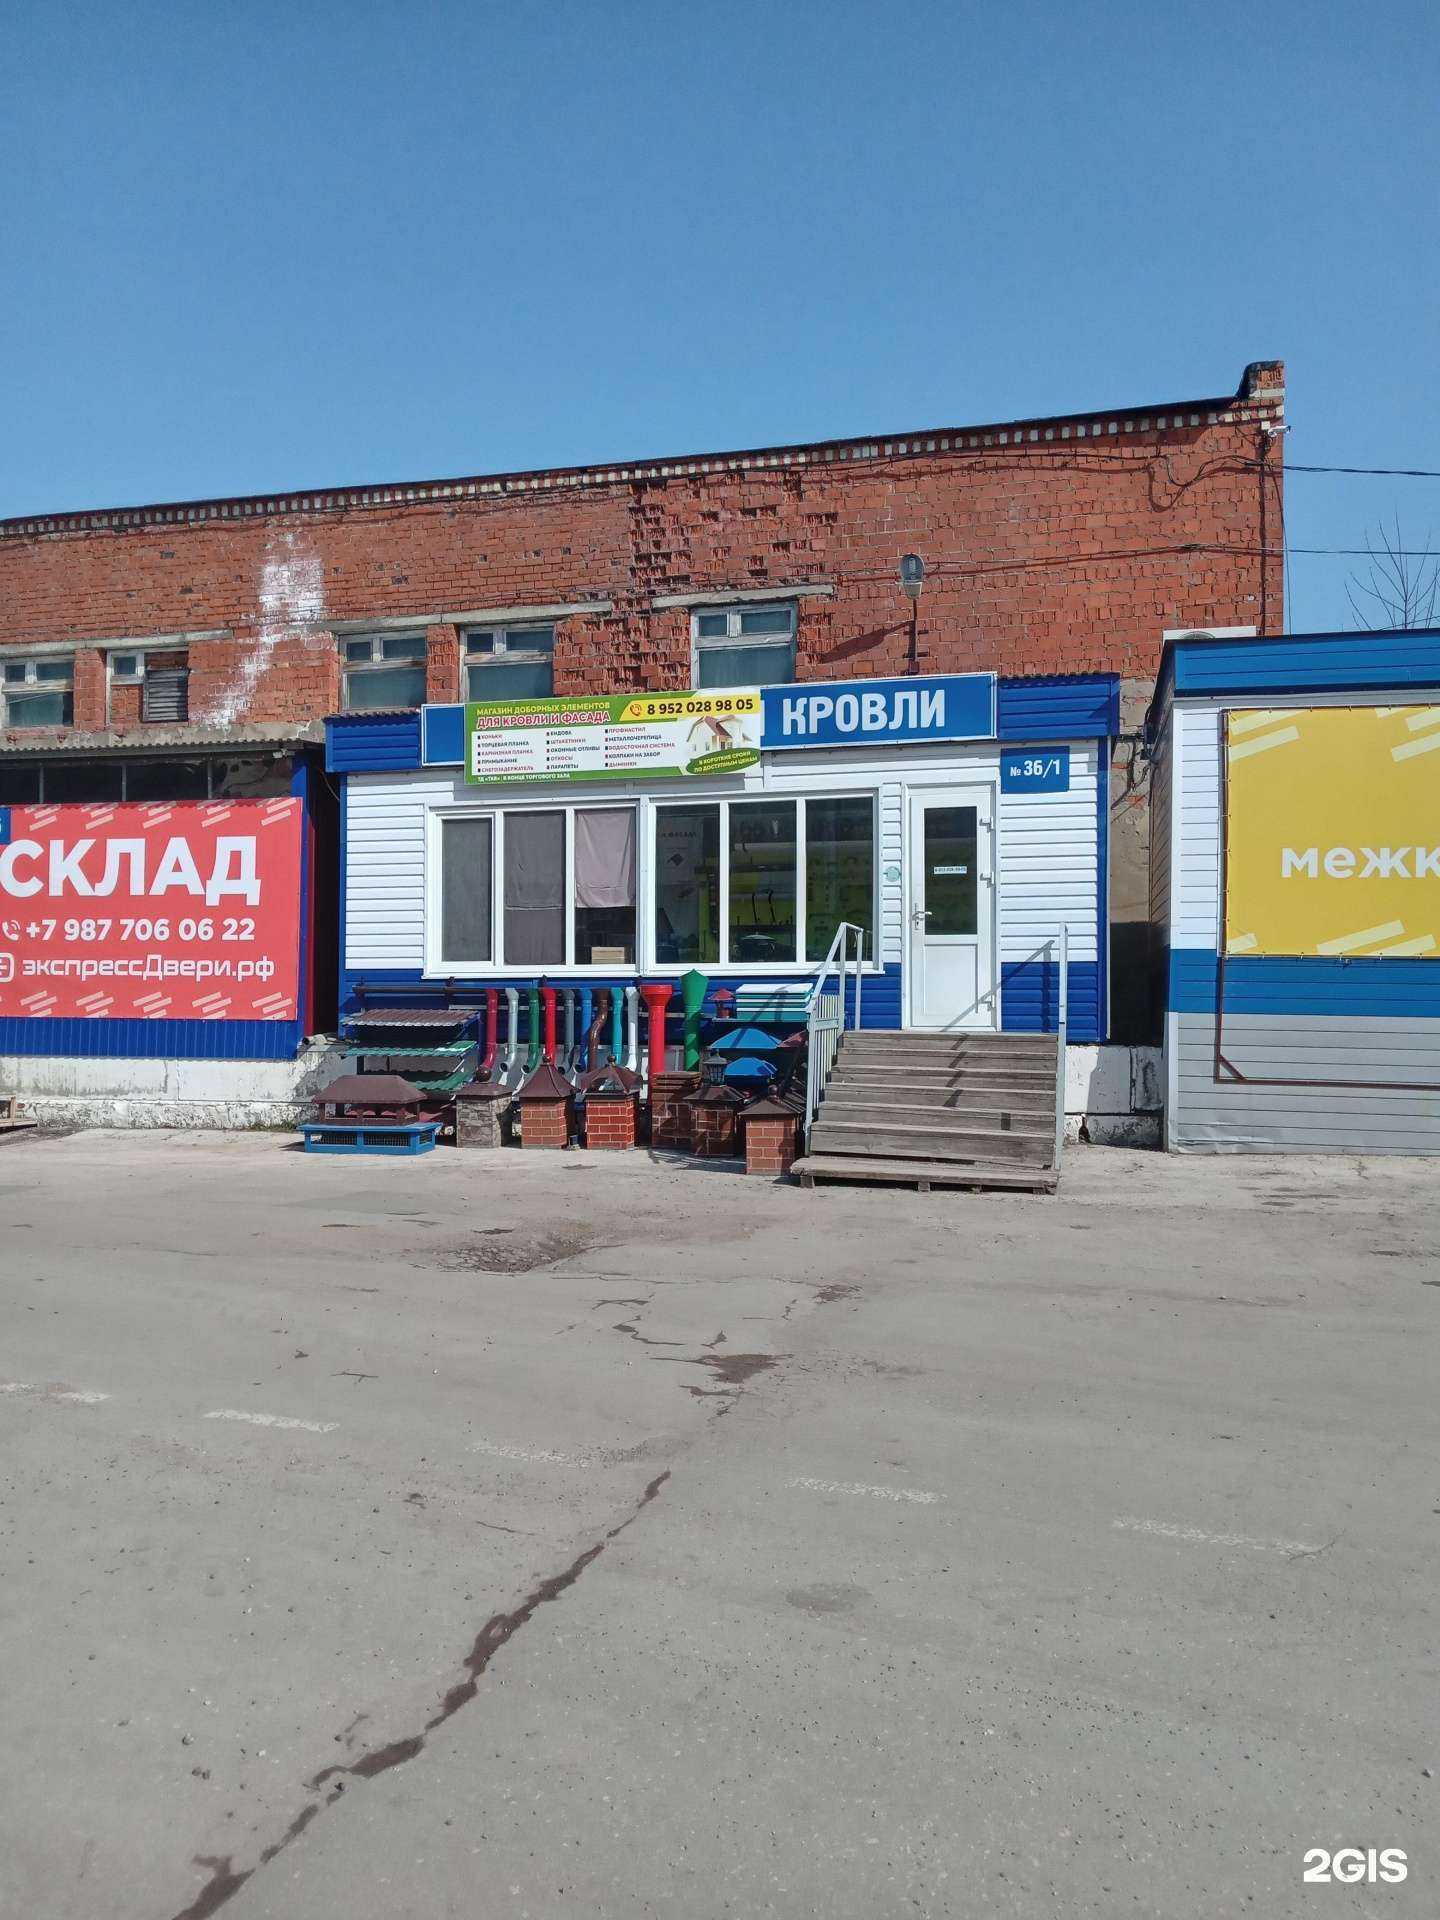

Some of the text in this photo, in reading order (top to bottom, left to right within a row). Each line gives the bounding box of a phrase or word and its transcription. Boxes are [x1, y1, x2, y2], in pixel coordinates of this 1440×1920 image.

[514, 705, 560, 714] ДОБОРНЫХ
[561, 702, 610, 711] ЭЛЕМЕНТОВ
[647, 699, 754, 715] 8 952 028 98 05
[782, 689, 945, 736] КРОВЛИ
[477, 711, 611, 729] ДЛЯ КРОВЛИ И ФАСАДА
[609, 734, 662, 742] МЕТАЛЛОЧЕРЕПИЦА
[481, 765, 534, 773] СНЕГОЗАДЕРЖАТЕЛЬ
[1010, 759, 1061, 778] № 36/1
[0, 835, 262, 906] СКЛАД
[1281, 847, 1440, 879] межк
[26, 917, 256, 941] +7 987 706 06 22
[22, 953, 275, 982] экспрессДвери.рф
